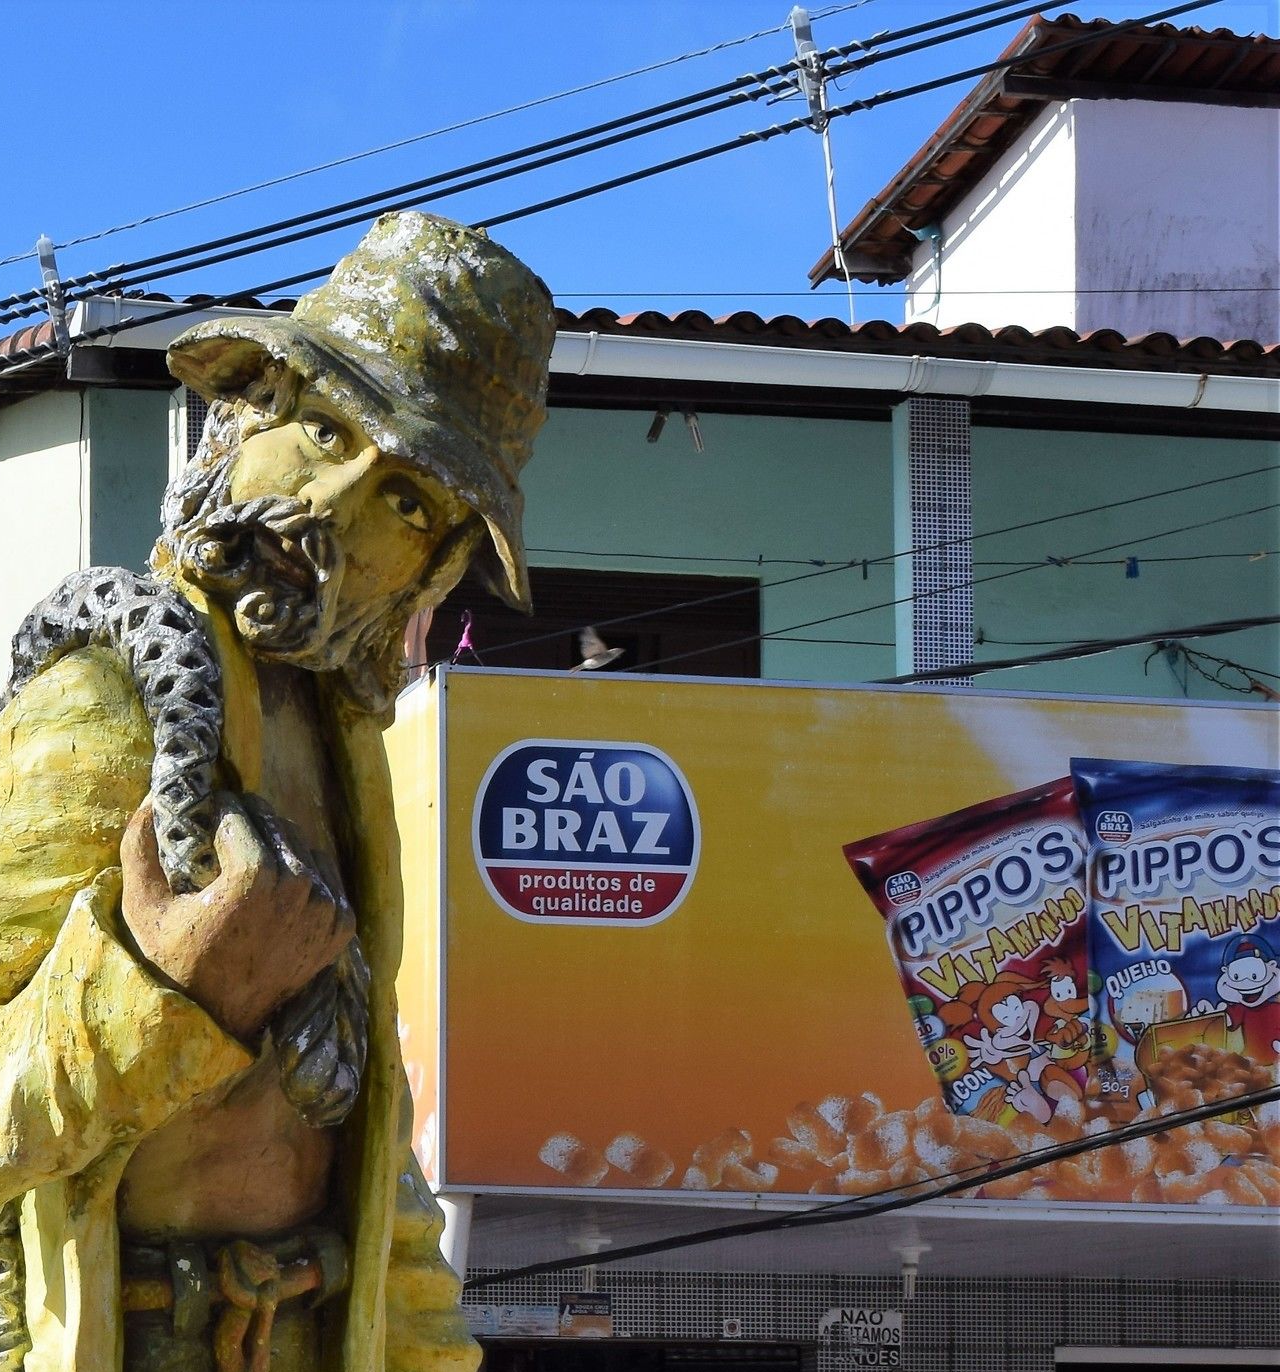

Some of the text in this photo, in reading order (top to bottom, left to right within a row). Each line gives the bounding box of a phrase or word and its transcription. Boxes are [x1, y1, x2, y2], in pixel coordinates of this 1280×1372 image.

[526, 751, 646, 807] SÃO
[501, 806, 671, 855] BRAZ
[1100, 822, 1129, 832] BRAZ
[518, 871, 656, 892] produtos de
[889, 881, 918, 896] BRAZ
[531, 893, 643, 914] qualidade
[917, 887, 1086, 998] VITAMINADO
[1105, 959, 1171, 1000] QUEIJO
[928, 1043, 956, 1066] 0%
[945, 1067, 994, 1114] ACON
[1101, 1081, 1130, 1098] 30g
[823, 1324, 900, 1344] AEITAMOS
